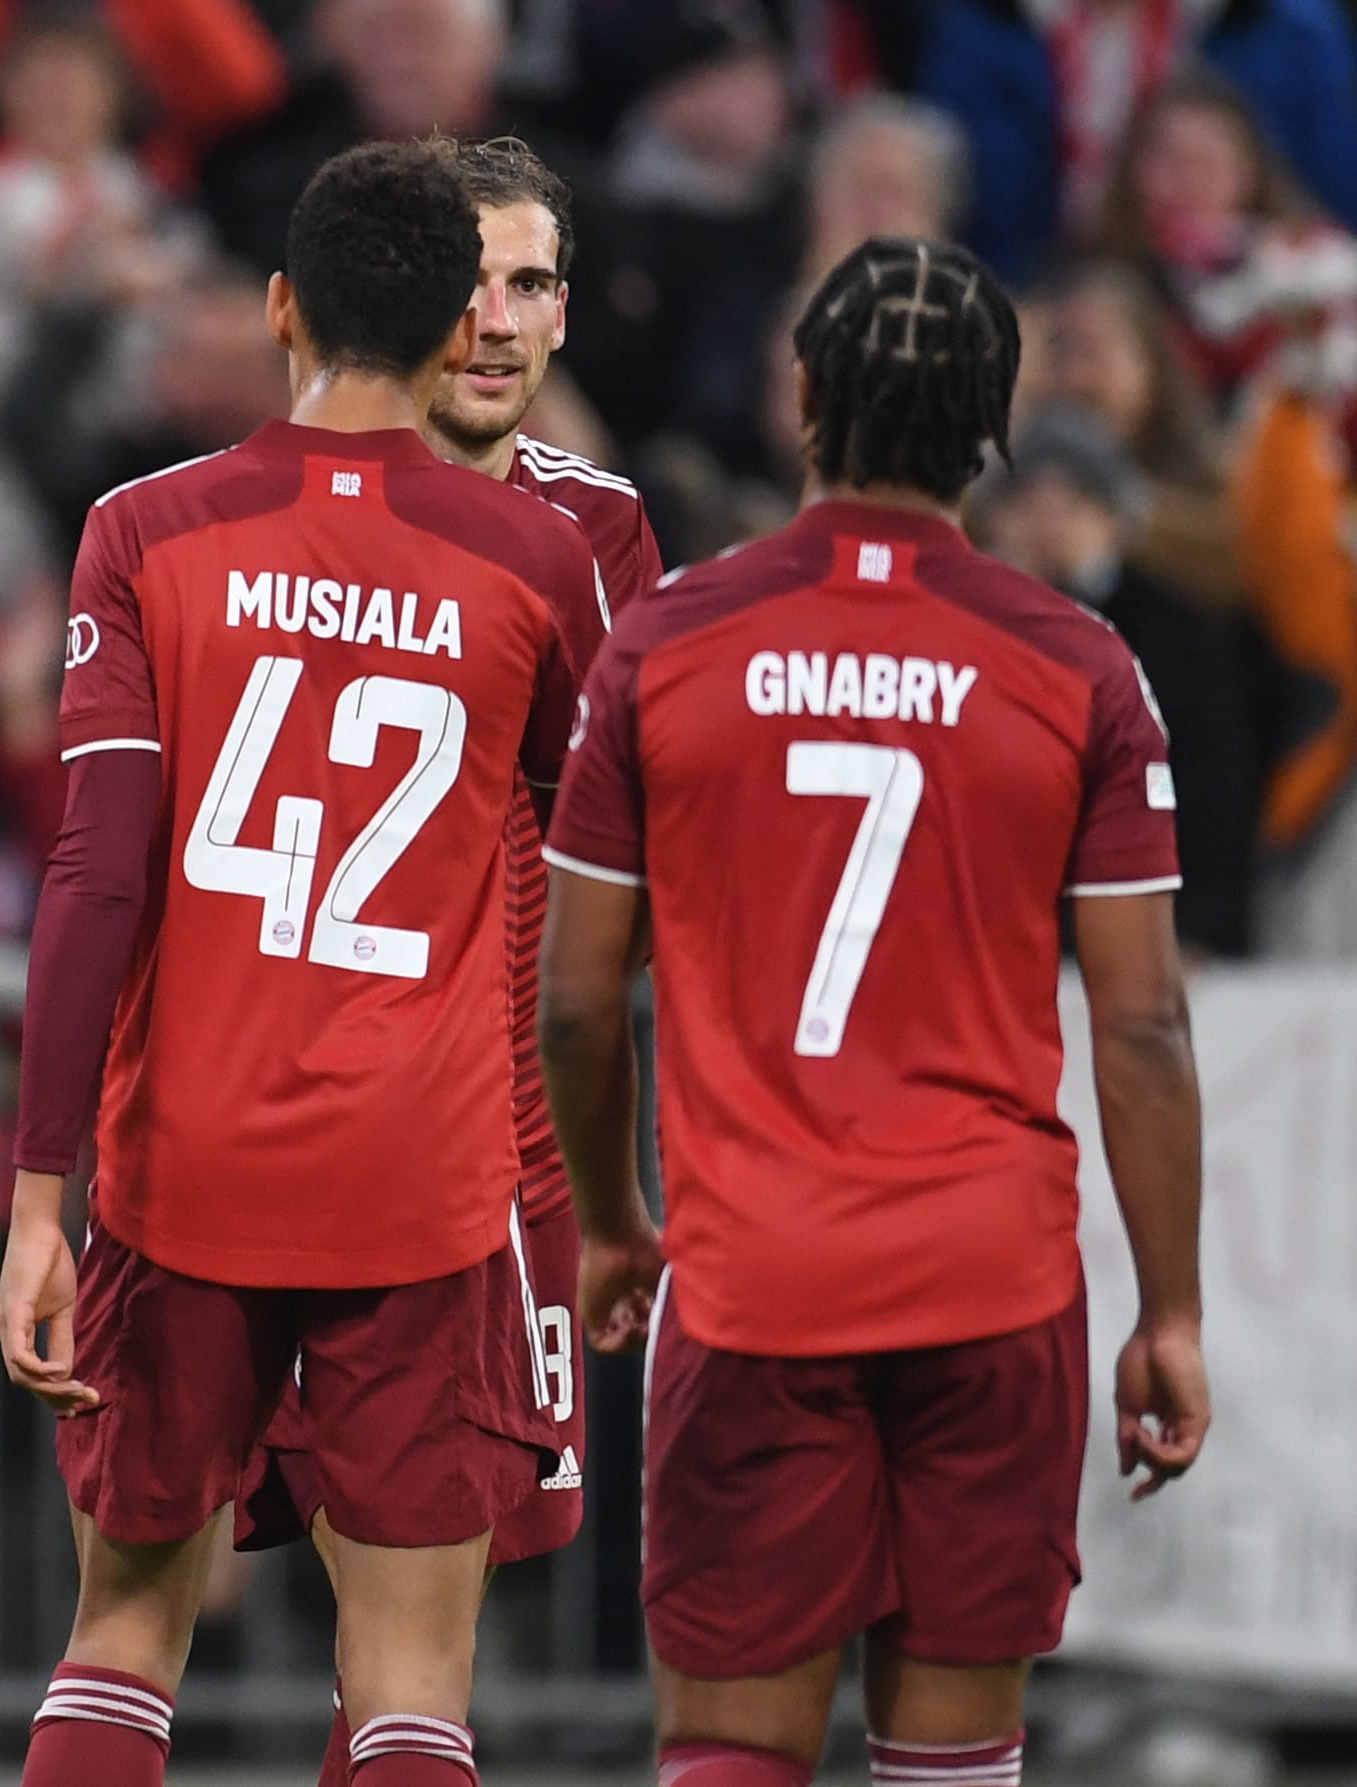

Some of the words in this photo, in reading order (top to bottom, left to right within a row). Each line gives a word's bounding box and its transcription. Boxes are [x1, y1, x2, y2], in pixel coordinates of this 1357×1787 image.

[225, 570, 463, 660] MUSIALA
[744, 650, 979, 727] GNABRY
[183, 655, 467, 979] 42
[786, 740, 925, 1058] 7
